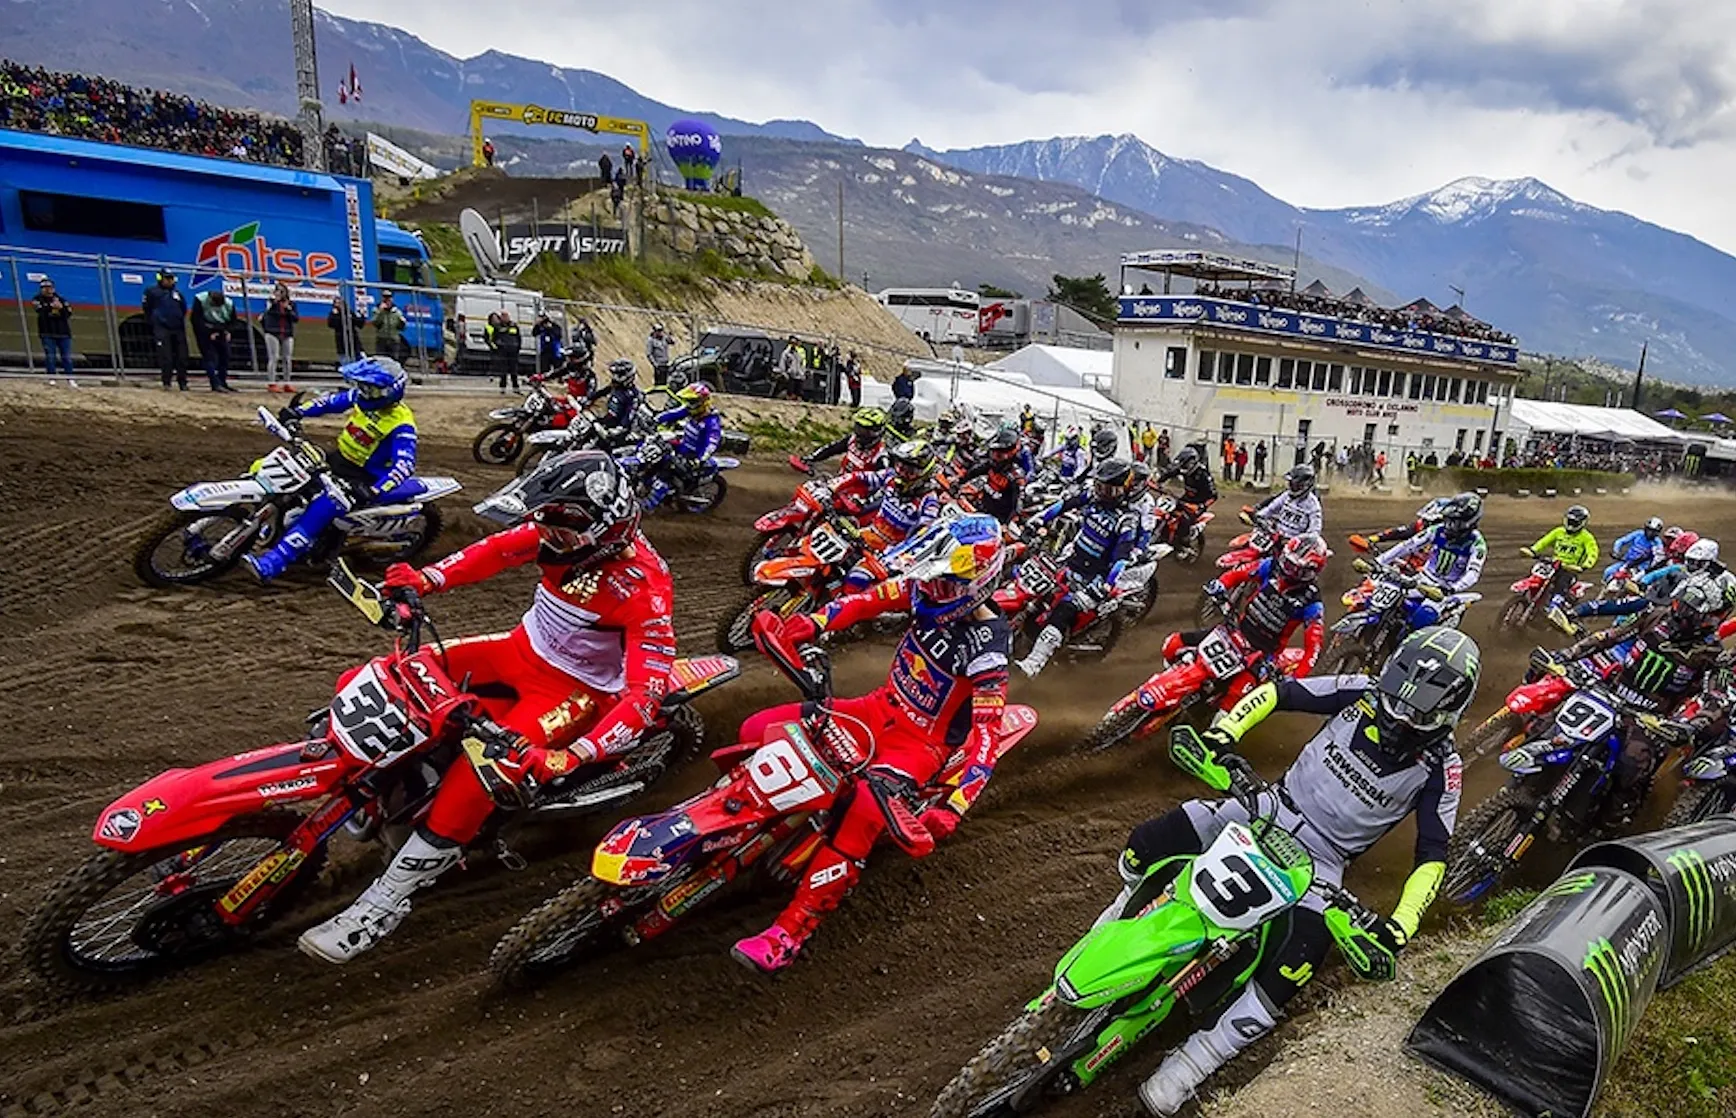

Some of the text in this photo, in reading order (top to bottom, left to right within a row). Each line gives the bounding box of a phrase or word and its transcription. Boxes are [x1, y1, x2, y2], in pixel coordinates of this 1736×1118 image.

[1203, 640, 1235, 674] 92
[331, 681, 417, 761] 32
[1560, 701, 1610, 738] 91
[748, 740, 825, 812] 61
[1322, 757, 1377, 810] Racing Team
[1324, 741, 1394, 809] Kawasaki
[810, 861, 847, 889] SIDI
[1195, 855, 1273, 919] 3
[1619, 909, 1663, 976] MONSTER
